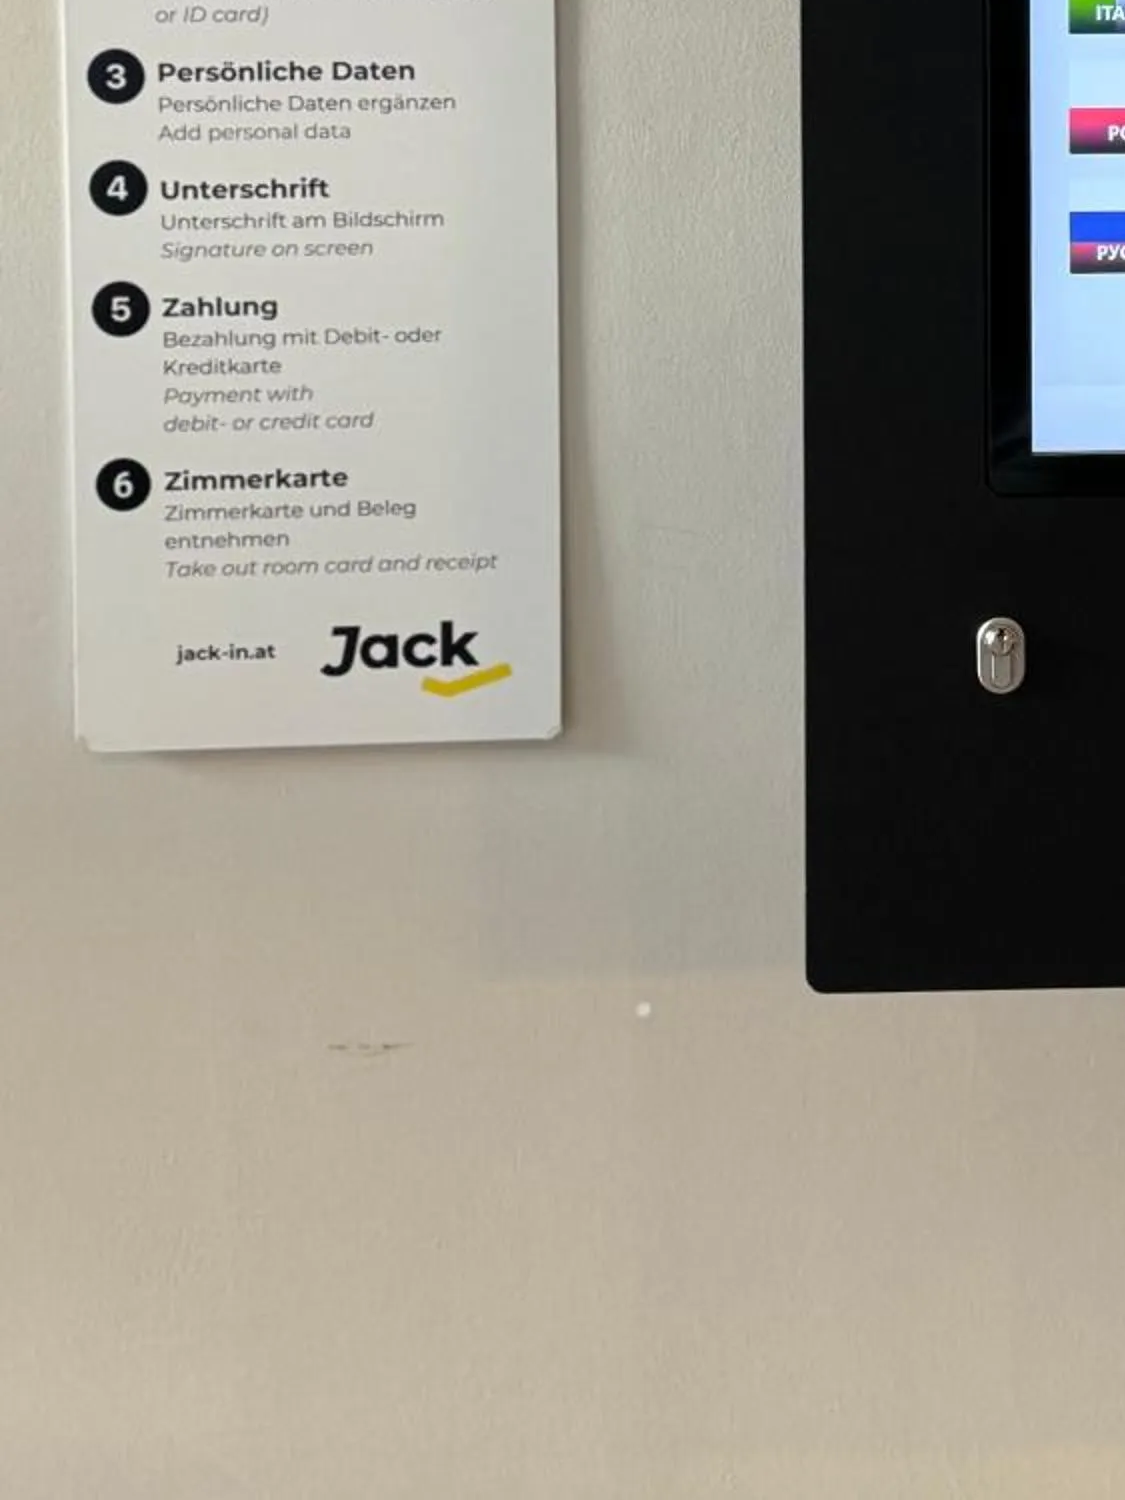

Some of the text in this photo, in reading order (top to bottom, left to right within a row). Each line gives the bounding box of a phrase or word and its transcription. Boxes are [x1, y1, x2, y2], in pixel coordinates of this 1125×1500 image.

[155, 6, 269, 26] or ID card)
[107, 60, 414, 89] 3 Persönliche Daten
[158, 95, 456, 114] Persönliche Daten ergänzen
[158, 123, 351, 144] Add personal data
[107, 176, 329, 200] 4 Unterschrift
[161, 211, 444, 231] Unterschrift am Bildschirm
[161, 242, 373, 262] Signature on screen
[112, 296, 277, 322] 5 Zahlung
[163, 327, 442, 350] Bezahlung mit Debit- oder
[164, 359, 282, 375] Kreditkarte
[164, 385, 313, 407] Payment with
[164, 412, 374, 433] debit- or credit card
[114, 469, 348, 498] 6 Zimmerkarte
[164, 500, 416, 522] Zimmerkarte und Beleg
[164, 532, 289, 550] entnehmen
[166, 553, 498, 578] Take out room card and receipt
[176, 644, 275, 665] jack-in.at
[321, 621, 479, 676] Jack
